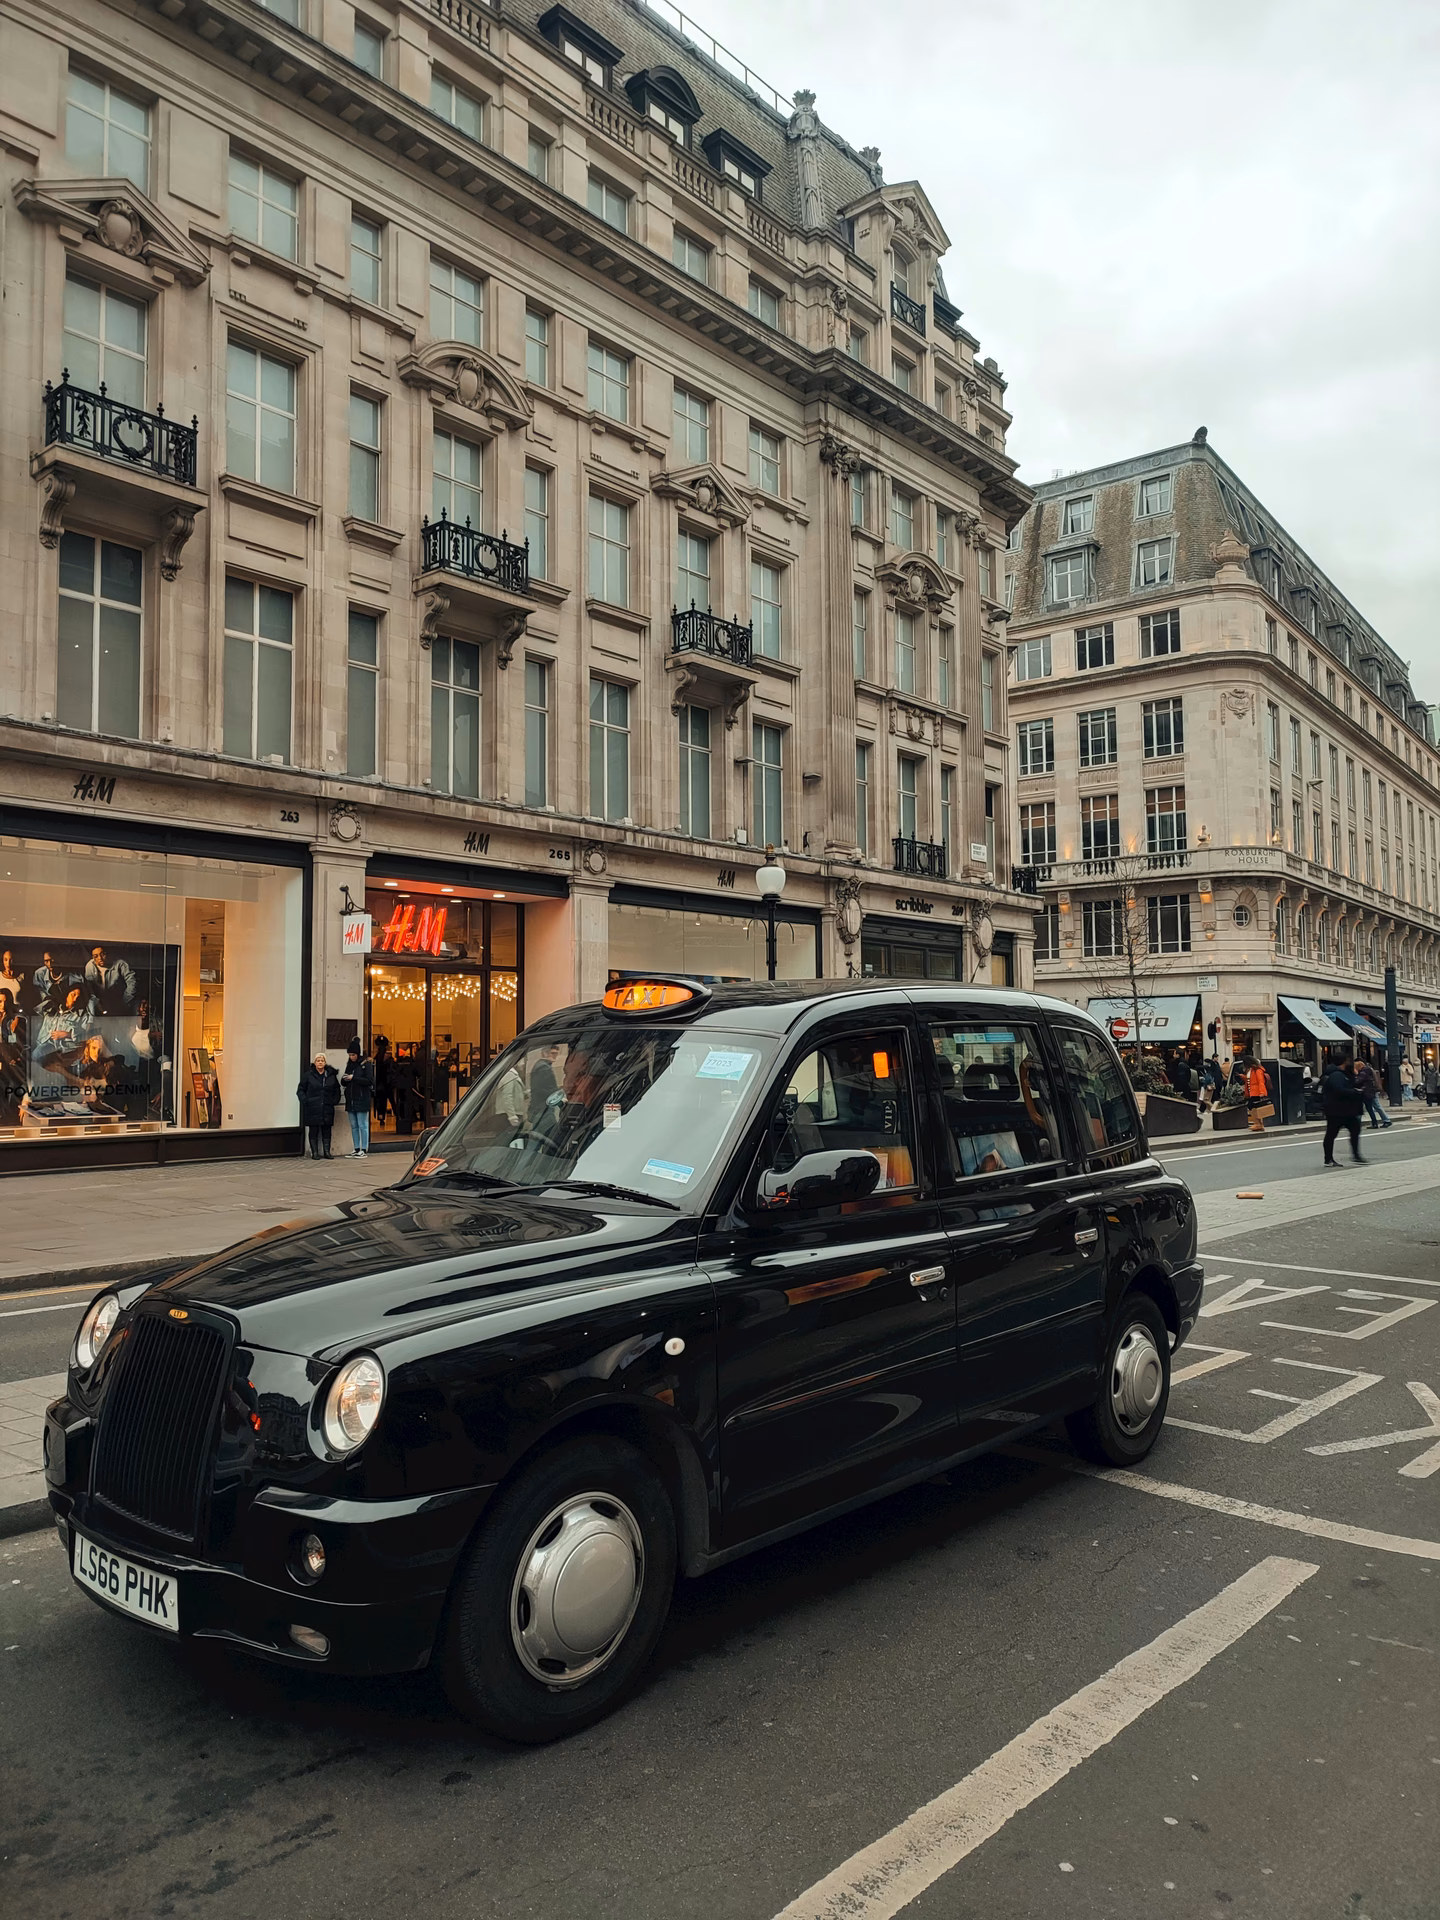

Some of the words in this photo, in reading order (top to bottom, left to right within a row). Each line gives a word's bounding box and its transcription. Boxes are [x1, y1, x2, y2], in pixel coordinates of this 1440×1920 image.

[73, 773, 116, 805] H&M
[280, 810, 300, 823] 263
[463, 831, 490, 855] H&M
[549, 849, 571, 861] 265
[895, 896, 934, 914] scribbler
[951, 905, 964, 917] 269
[344, 922, 365, 945] H&M
[381, 904, 448, 957] H&M
[613, 986, 667, 1008] TAXI
[705, 1059, 733, 1068] 77023
[4, 1085, 81, 1098] POWERED
[84, 1085, 102, 1096] BY
[105, 1083, 151, 1096] DENIM
[79, 1537, 120, 1596] LS66
[125, 1564, 170, 1619] PHK
